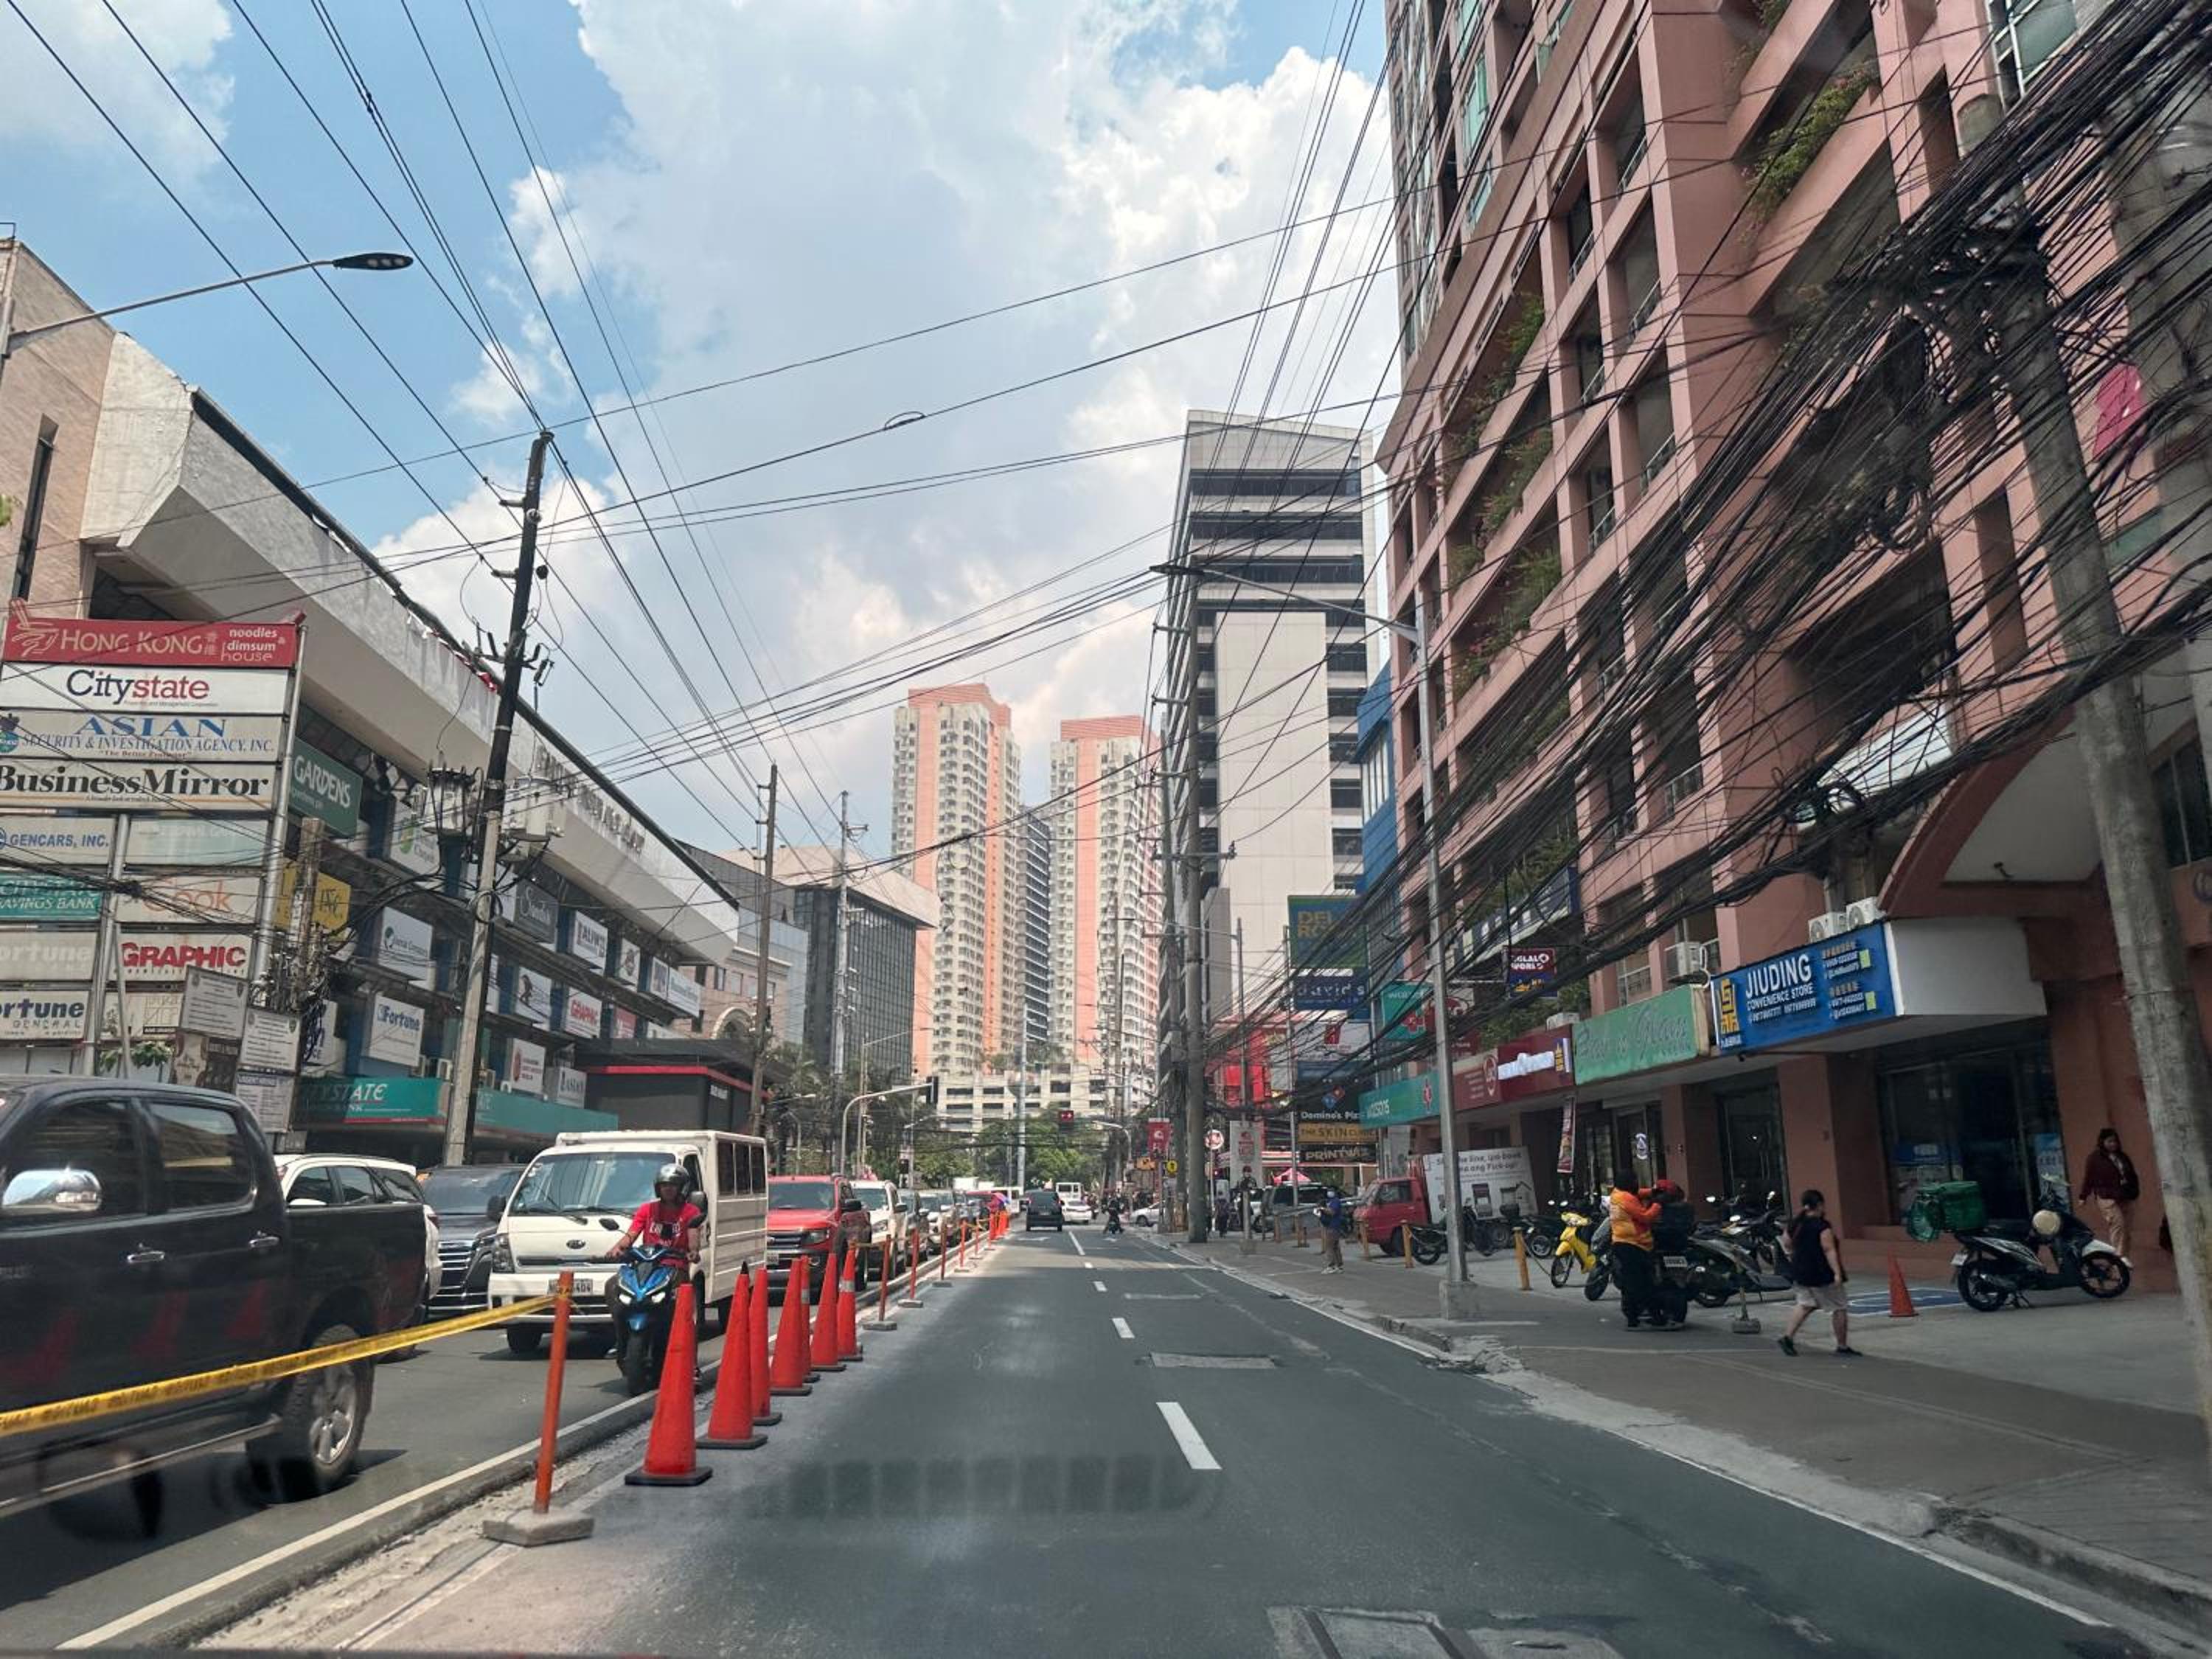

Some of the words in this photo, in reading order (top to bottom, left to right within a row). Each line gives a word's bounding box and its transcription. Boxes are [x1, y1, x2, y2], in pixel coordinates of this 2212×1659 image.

[60, 629, 129, 653] HONG
[136, 631, 203, 654] KONG
[229, 627, 278, 639] noodles
[220, 643, 274, 661] house
[226, 640, 276, 651] dimsum
[66, 669, 210, 705] Citystate
[74, 715, 227, 738] ASIAN
[22, 734, 83, 749] SECURITY
[85, 736, 95, 749] &
[97, 735, 192, 752] INVESTIGATION
[195, 738, 247, 754] AGENCY,
[250, 740, 275, 753] INC.
[0, 765, 269, 795] BusinessMirror
[293, 755, 351, 809] GARDENS
[10, 834, 77, 848] GENCARS,
[82, 835, 109, 847] INC.
[56, 897, 96, 909] BANK
[0, 943, 91, 961] ortune
[121, 942, 246, 967] GRAPHIC
[1745, 953, 1812, 998] JIUDING
[1747, 990, 1789, 1011] CONVENIENCE
[1791, 982, 1814, 999] STORE
[0, 998, 85, 1018] rtune
[13, 1020, 81, 1029] GENERAL
[1318, 1127, 1347, 1137] SKIN
